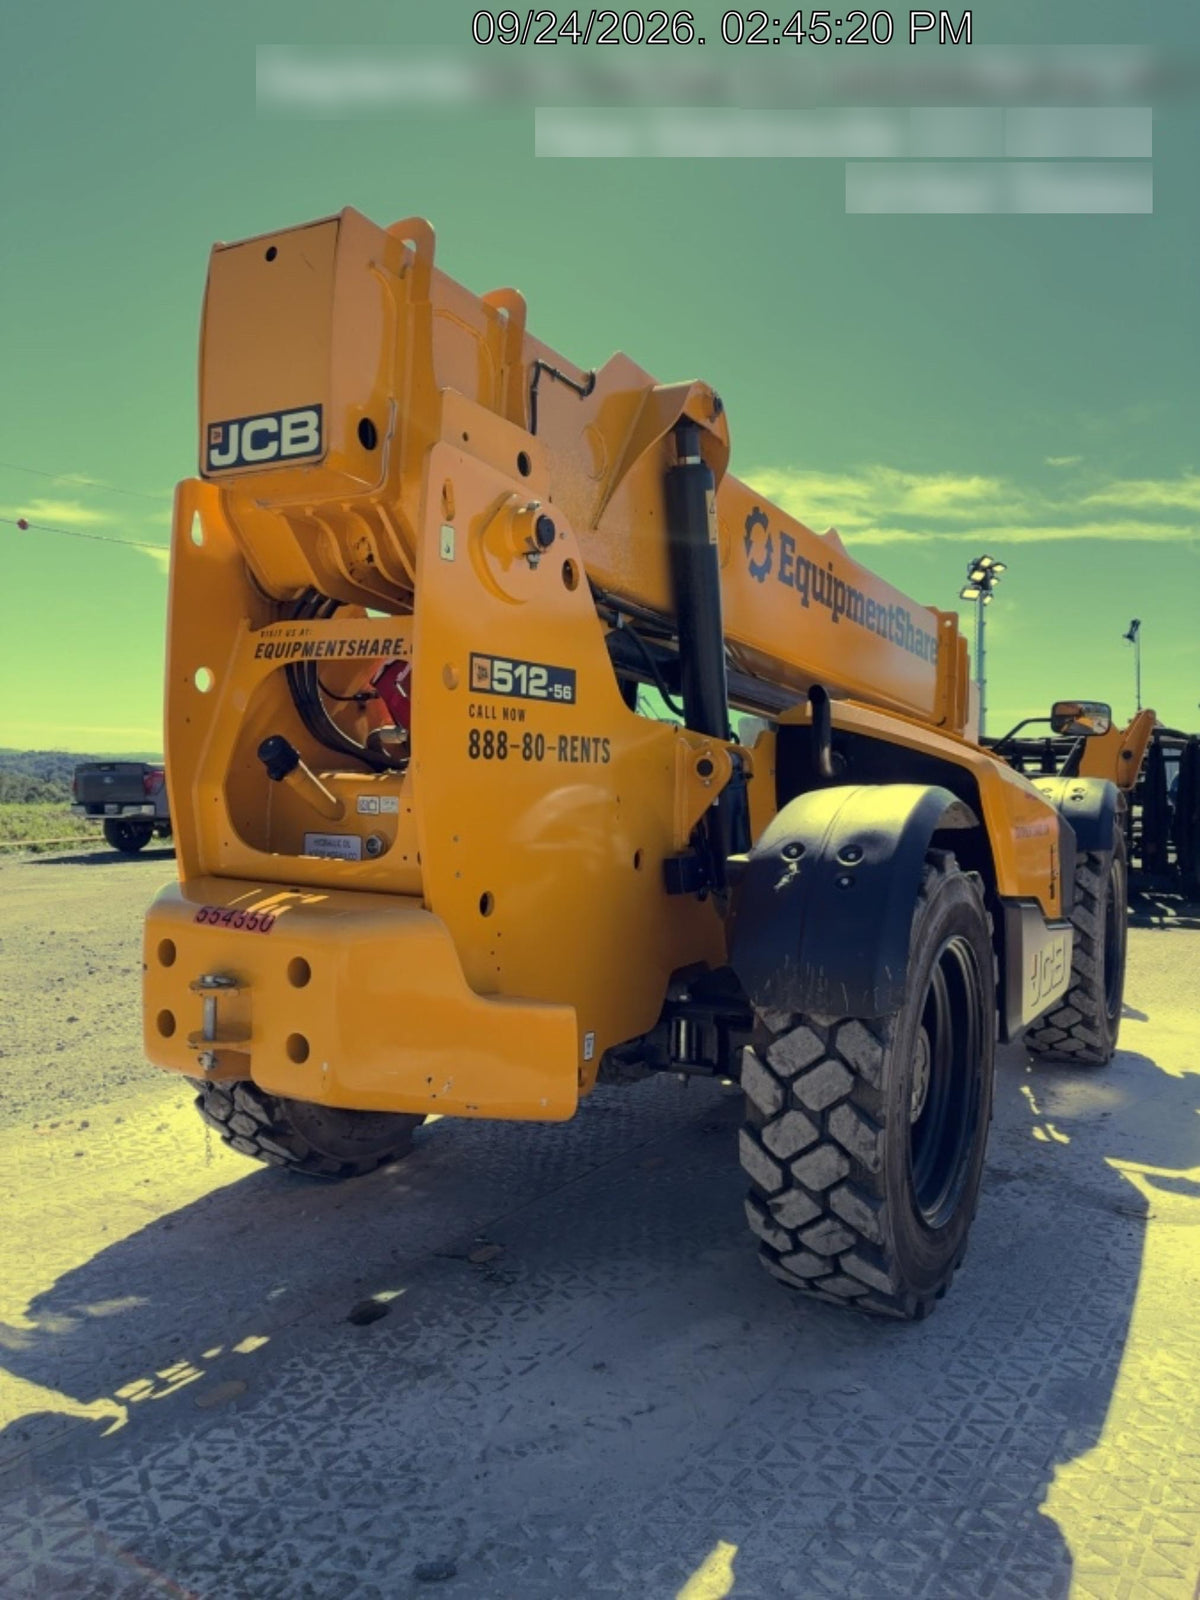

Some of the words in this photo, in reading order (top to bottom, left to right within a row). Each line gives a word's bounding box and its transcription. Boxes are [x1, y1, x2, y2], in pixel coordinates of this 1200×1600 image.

[209, 410, 320, 467] JCB
[777, 530, 938, 666] EquipmentShare
[254, 638, 413, 659] EQUIPMENTSHARE.
[468, 704, 497, 720] CALL
[502, 707, 526, 722] NOW
[468, 728, 611, 763] 888-80-RENTS
